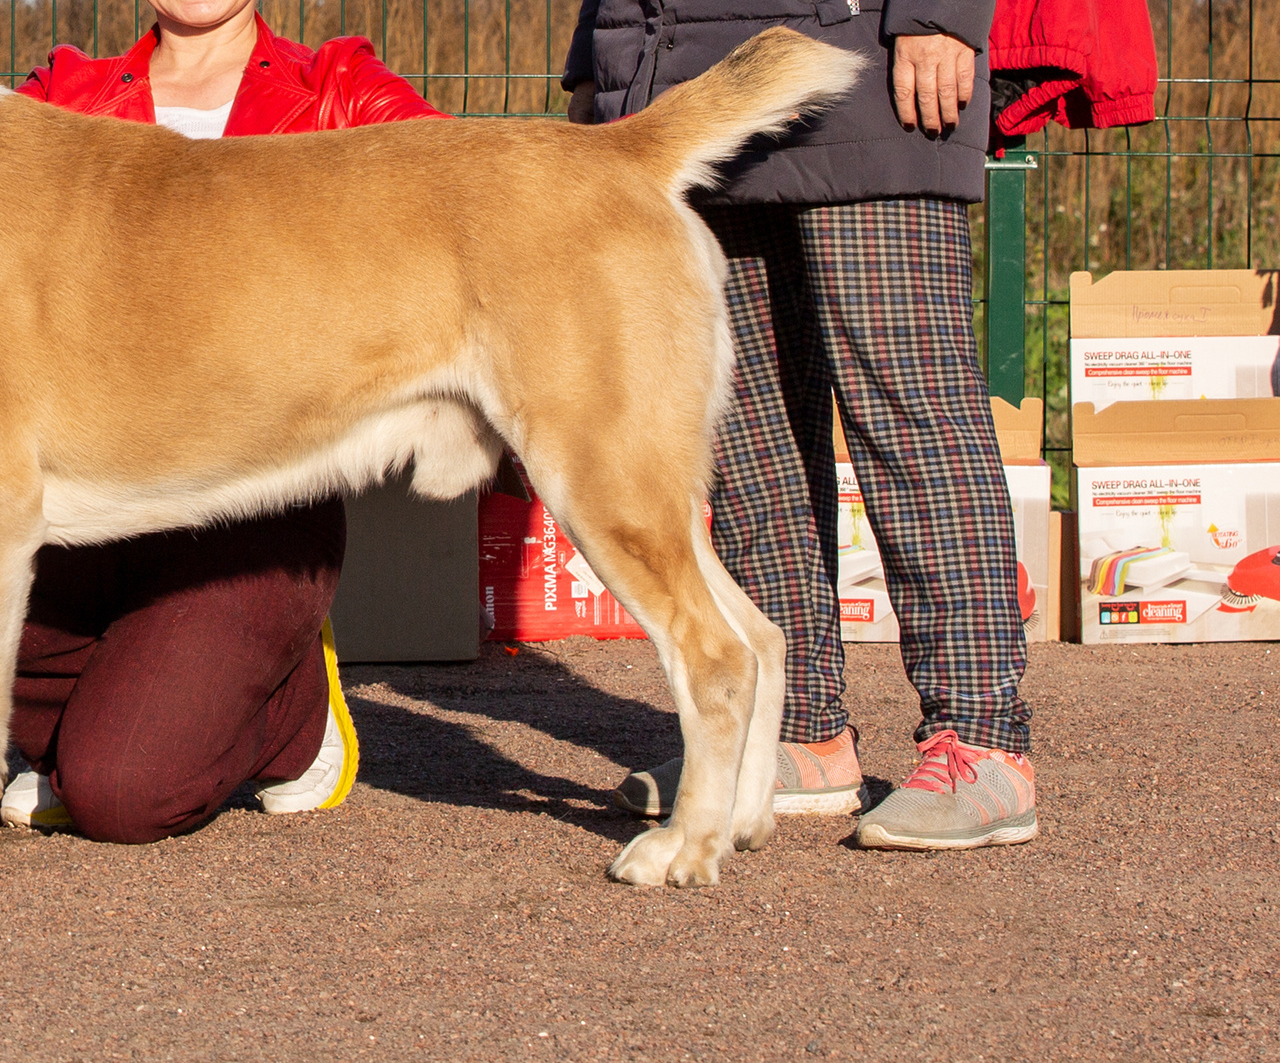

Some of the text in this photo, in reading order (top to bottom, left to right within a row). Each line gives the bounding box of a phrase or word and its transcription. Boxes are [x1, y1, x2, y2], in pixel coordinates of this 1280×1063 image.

[1084, 349, 1192, 361] SWEEP DRAG ALL-IN-ONE
[1091, 478, 1200, 490] SWEEP DRAG ALL-IN-ONE
[542, 506, 558, 611] PIXMA MG3640
[1142, 603, 1183, 622] cleaning
